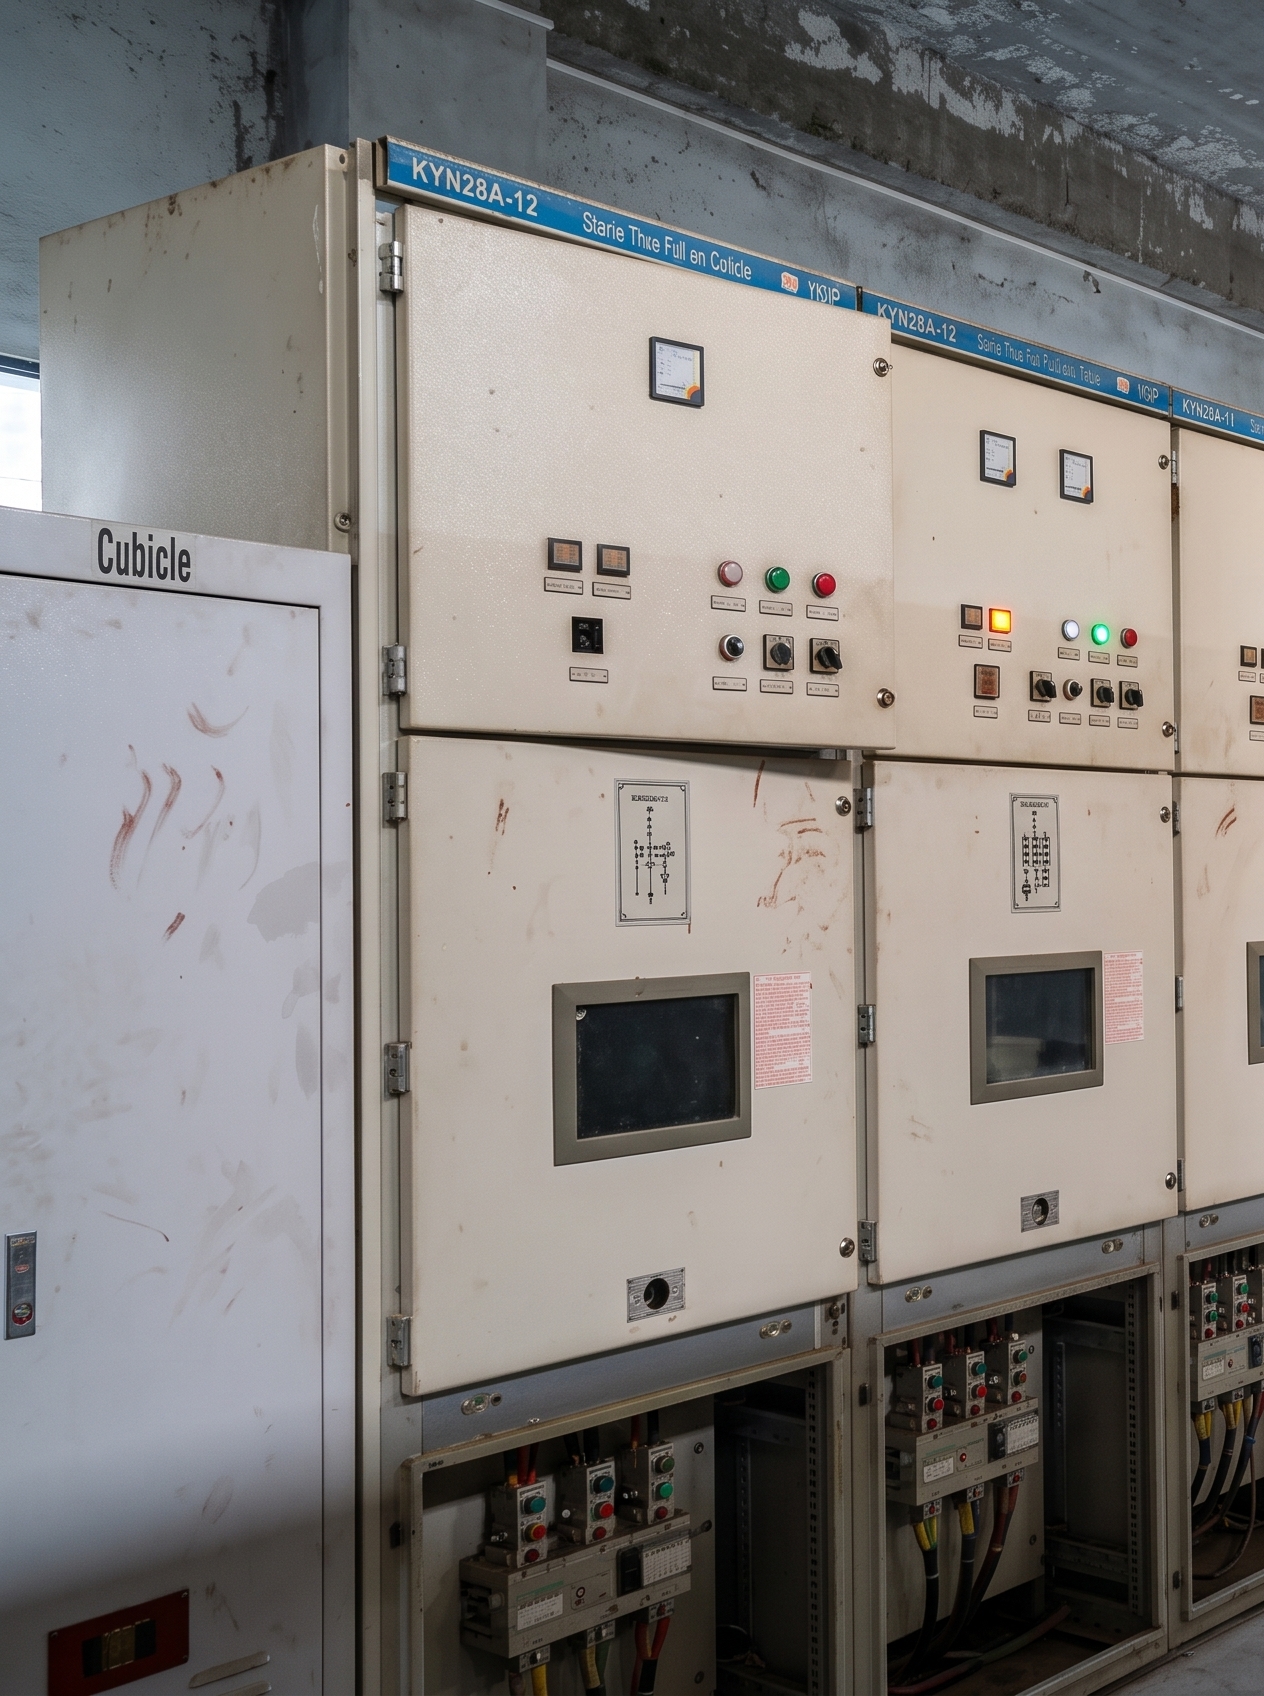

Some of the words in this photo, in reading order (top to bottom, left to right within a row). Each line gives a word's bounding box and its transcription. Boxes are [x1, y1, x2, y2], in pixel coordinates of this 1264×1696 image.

[412, 157, 538, 217] KYN28A-12
[877, 302, 957, 343] KYN28A-12
[97, 527, 191, 583] Cubicle
